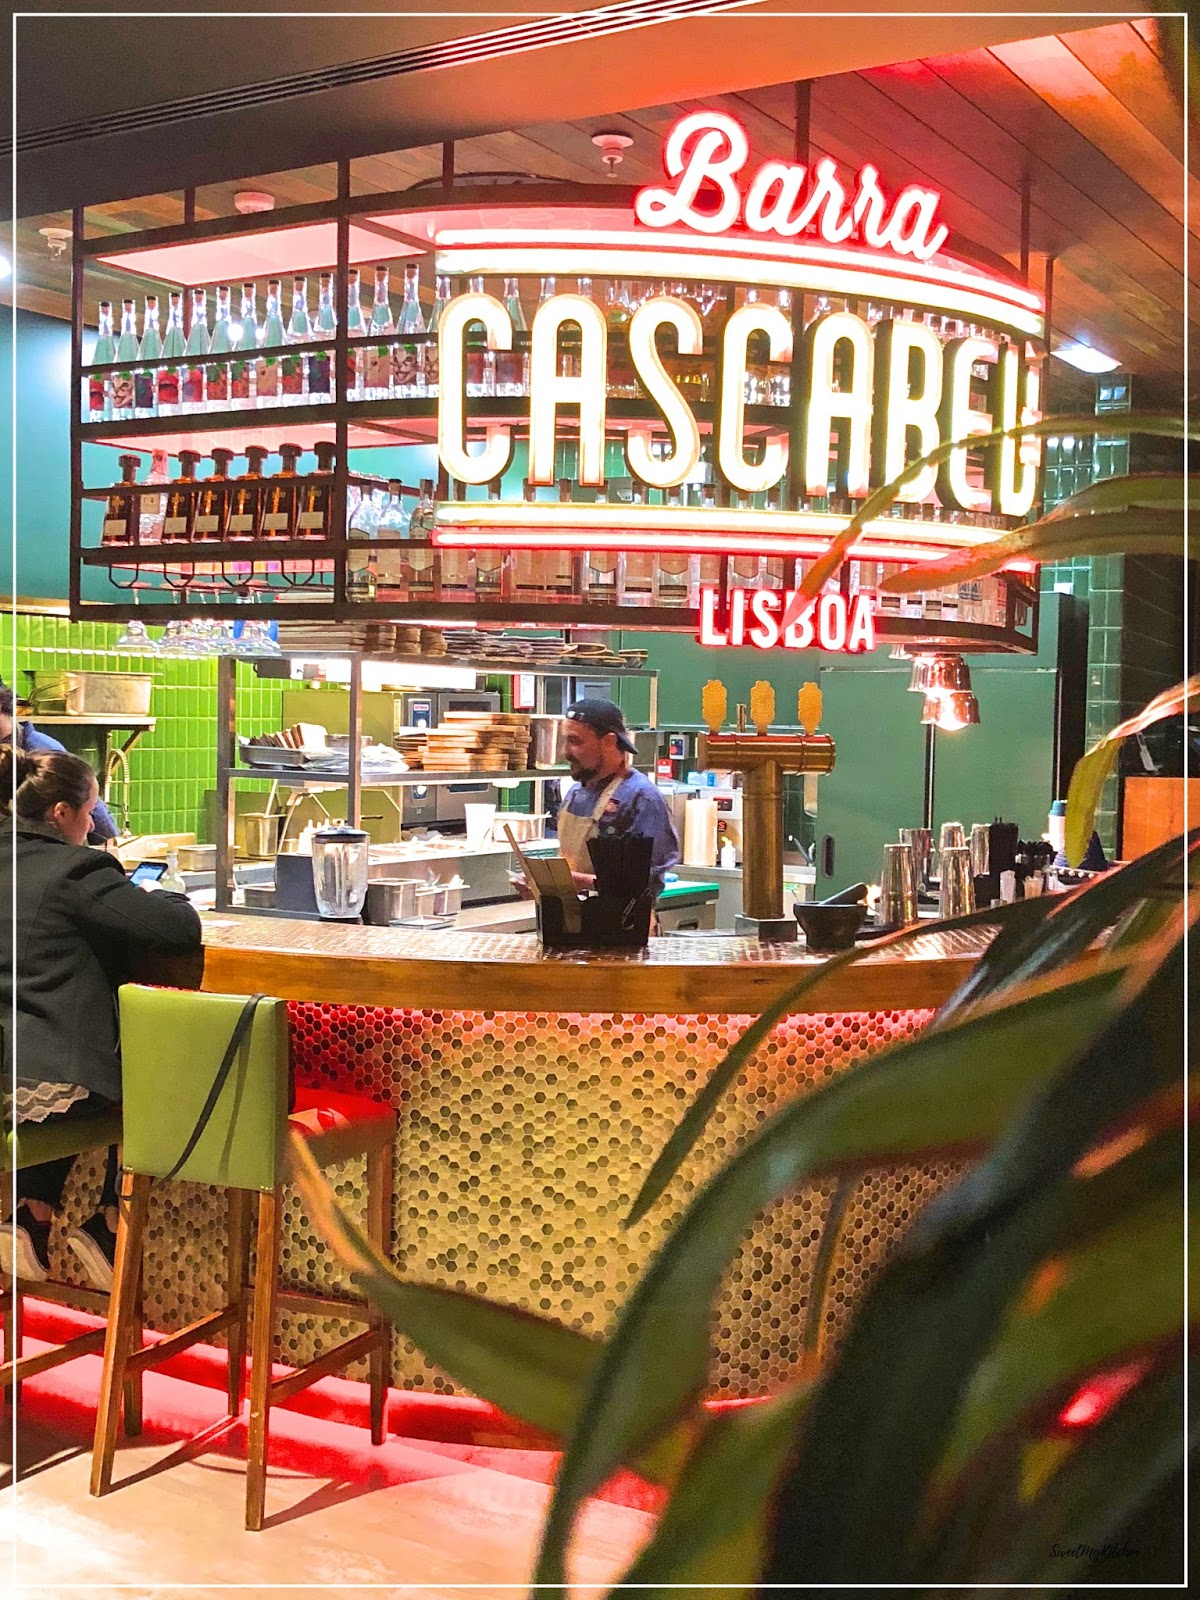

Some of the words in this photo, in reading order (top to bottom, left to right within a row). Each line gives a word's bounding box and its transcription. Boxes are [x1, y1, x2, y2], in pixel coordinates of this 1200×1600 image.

[634, 109, 949, 261] Barra
[436, 292, 1037, 517] CASCABEL
[700, 587, 876, 652] LISBOA
